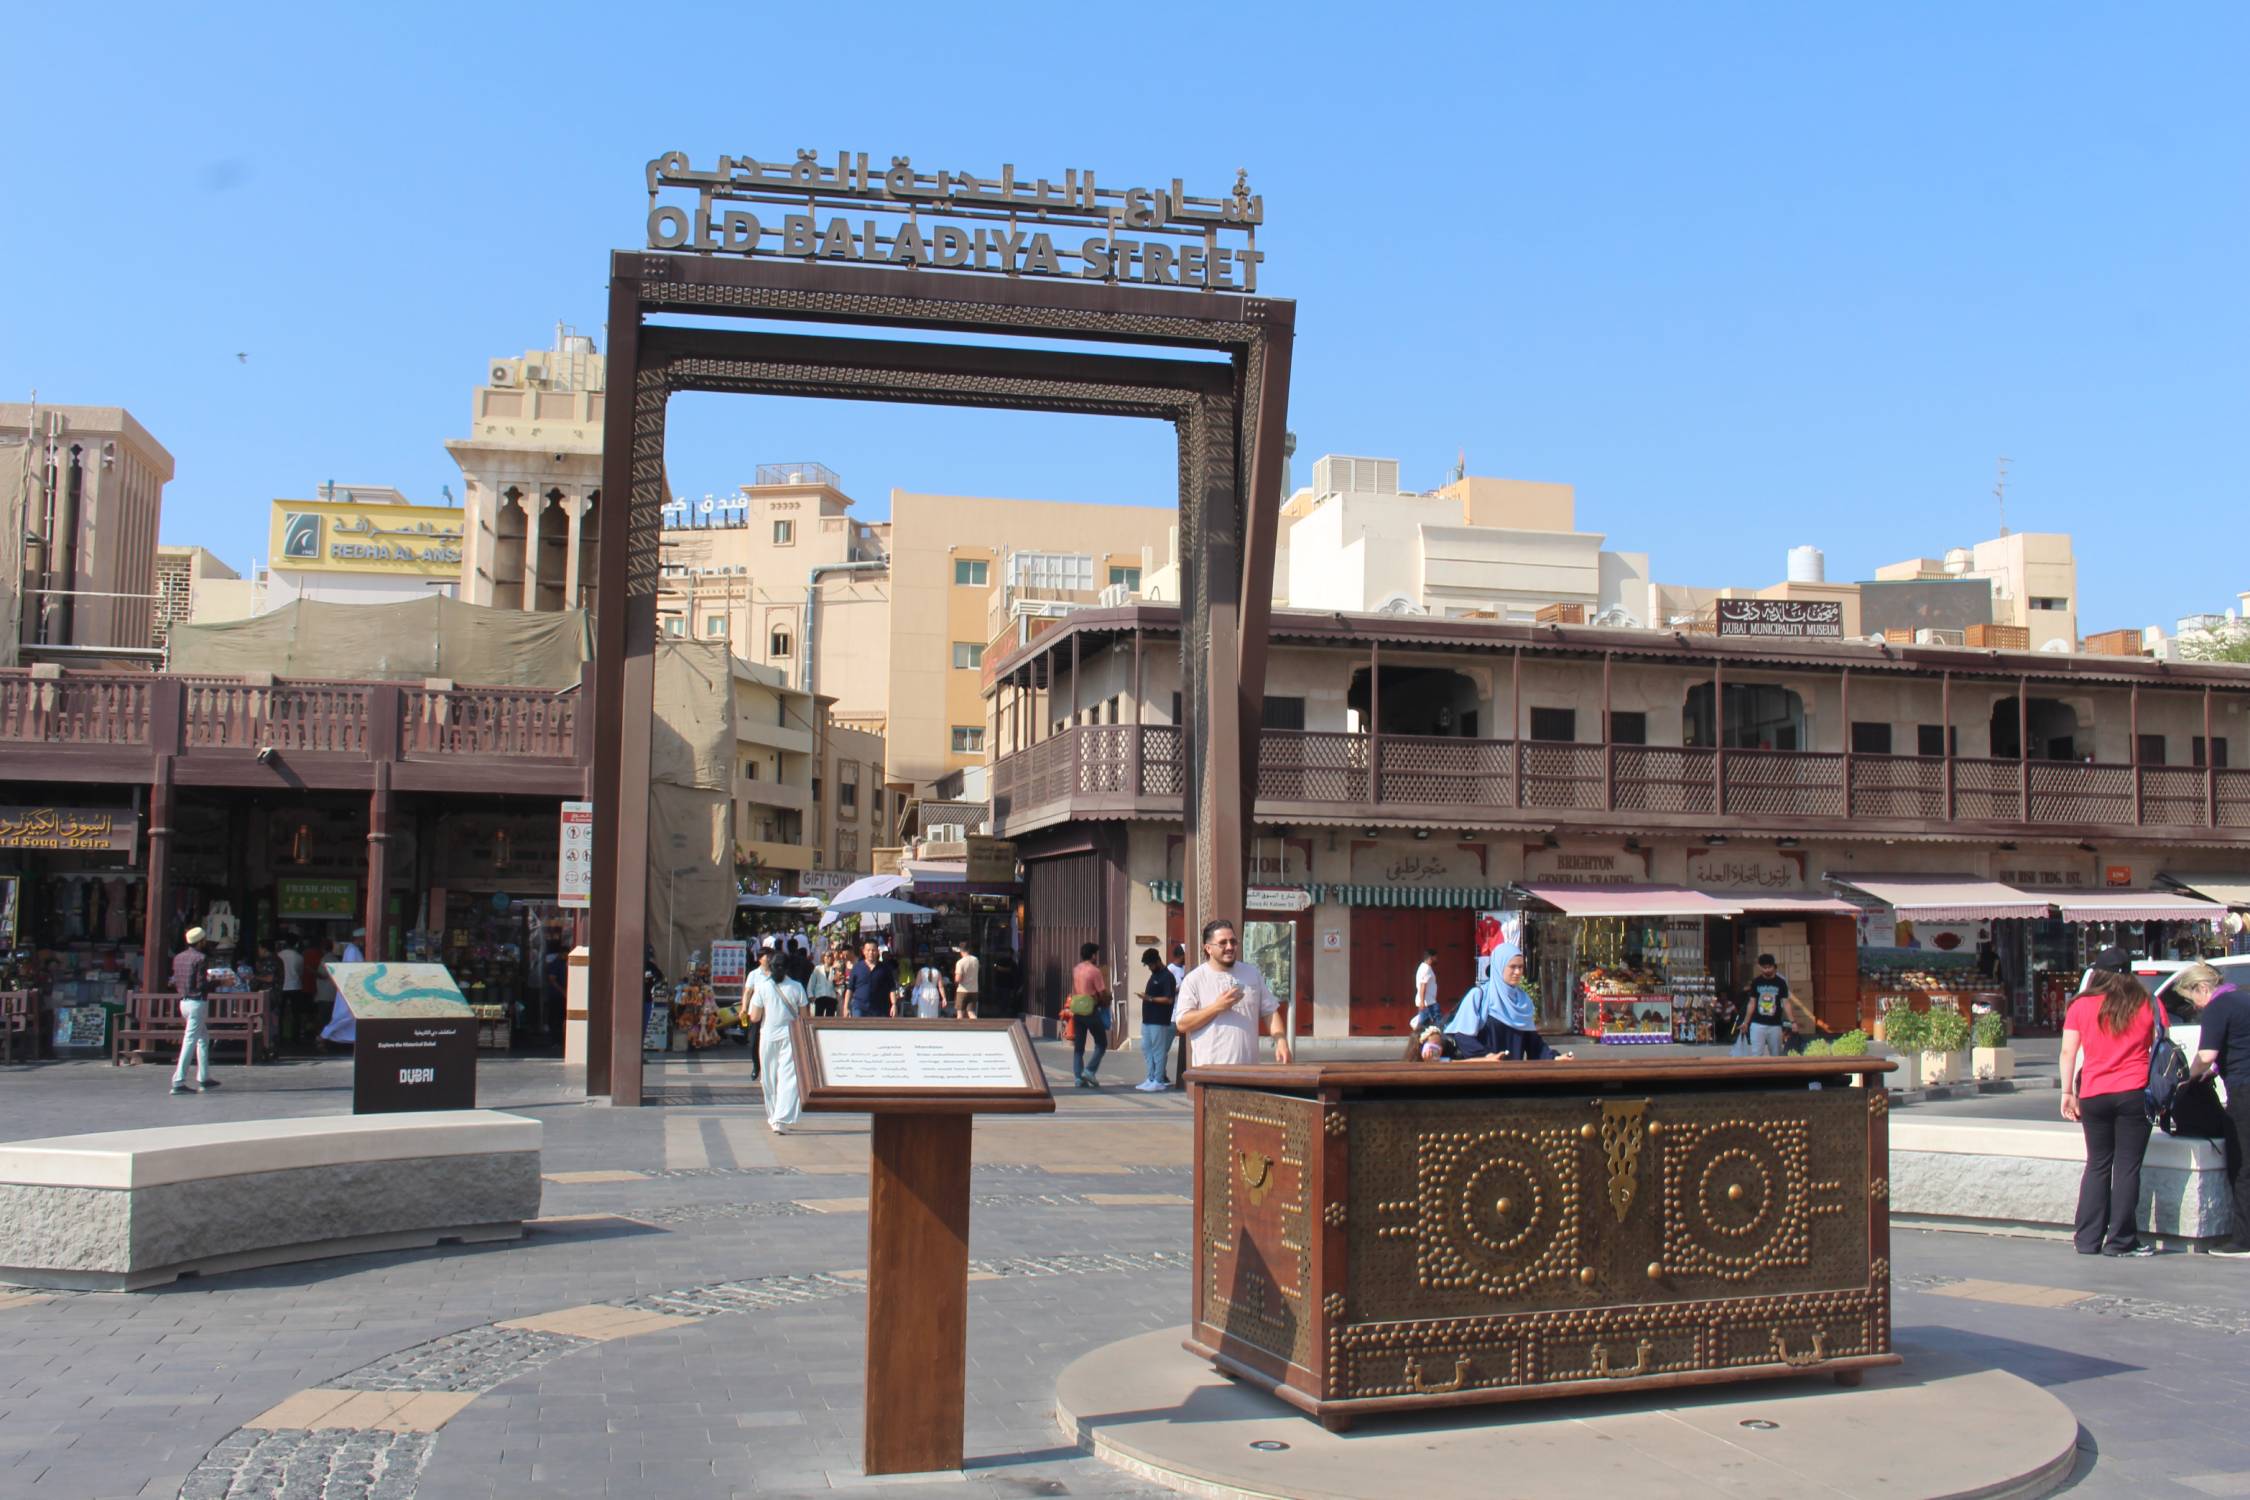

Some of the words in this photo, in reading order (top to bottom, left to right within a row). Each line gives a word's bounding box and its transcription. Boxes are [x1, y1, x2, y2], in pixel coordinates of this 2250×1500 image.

[886, 156, 1096, 219] البلدية
[1124, 167, 1264, 230] شارع
[646, 206, 761, 255] OLD
[783, 213, 1061, 275] BALADIYA
[1082, 236, 1265, 292] STREET
[699, 492, 749, 514] فندق
[331, 543, 390, 561] REDHA
[1721, 601, 1761, 622] دبي
[1762, 602, 1806, 623] بلدية
[1806, 602, 1839, 622] متحف
[1722, 622, 1747, 634] DUBAI
[1750, 623, 1804, 636] MUNICIPALITY
[1806, 624, 1840, 636] MUSEUM
[23, 836, 58, 849] Souq
[69, 837, 111, 849] Deira
[1250, 856, 1291, 873] TORE
[1557, 855, 1615, 870] BRIGHTON
[803, 871, 826, 886] GIFT
[827, 872, 857, 887] TOWN
[1537, 873, 1584, 884] GENERAL
[1588, 874, 1634, 884] TRADING
[286, 884, 321, 894] FRESH
[322, 884, 352, 894] JUICE
[399, 1067, 434, 1084] DUBAI
